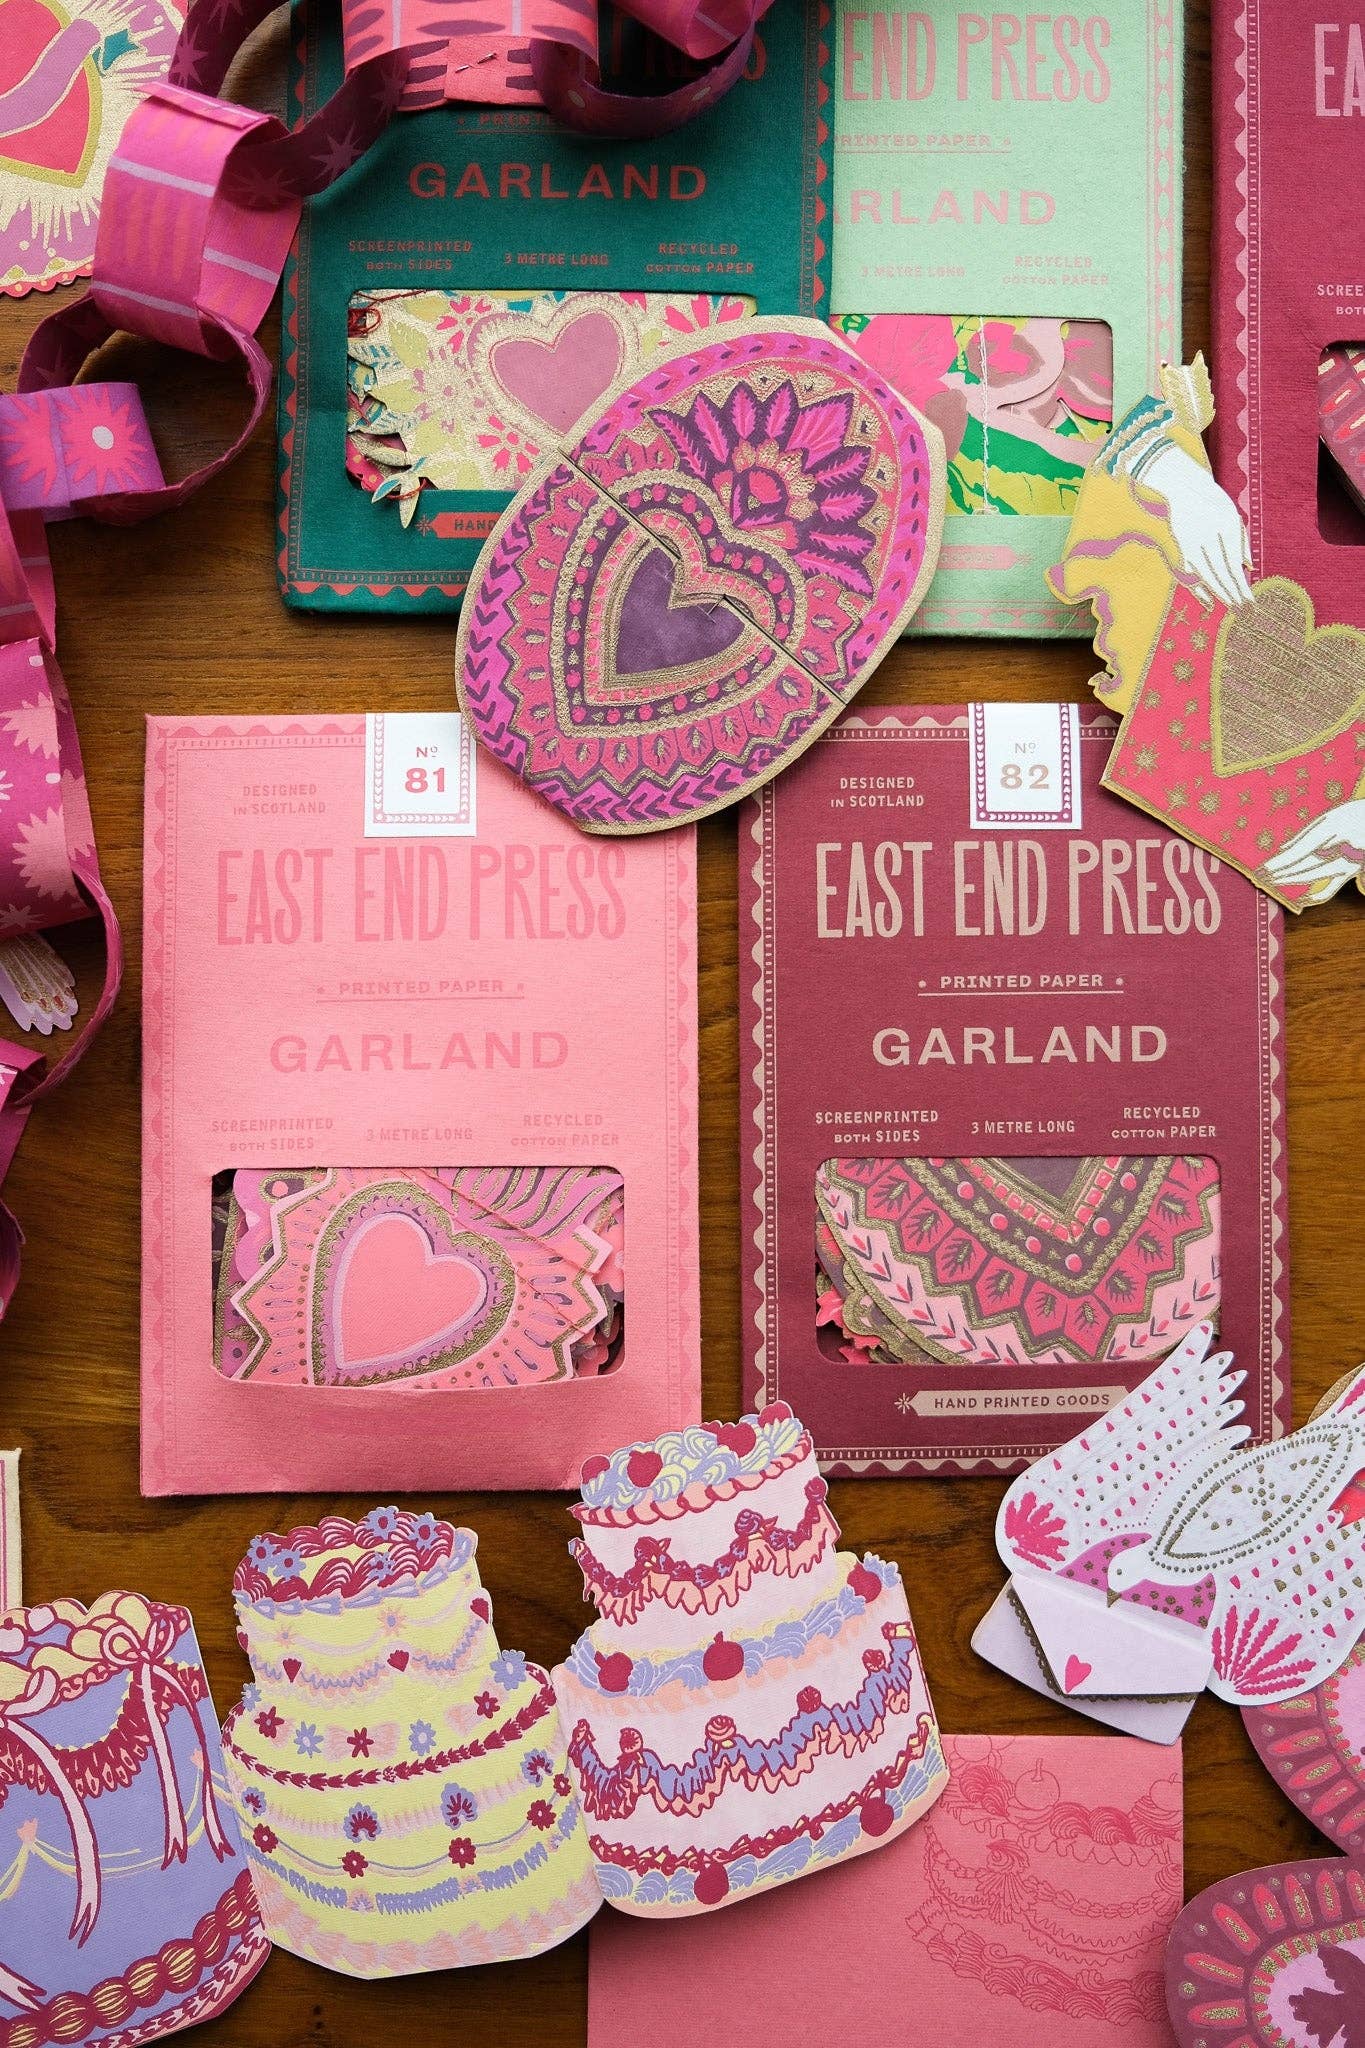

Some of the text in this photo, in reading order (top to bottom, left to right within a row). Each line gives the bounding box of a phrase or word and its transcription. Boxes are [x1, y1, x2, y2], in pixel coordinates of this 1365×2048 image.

[843, 11, 937, 101] END
[956, 13, 1112, 104] PRESS
[1314, 23, 1365, 117] EA
[927, 134, 991, 147] PAPER
[408, 162, 707, 200] GARLAND
[348, 240, 473, 254] SCREENPRINTED
[658, 242, 739, 255] RECYCLED
[366, 257, 454, 271] BOTH SIDES
[504, 253, 609, 266] 3 METRE LONG
[1014, 256, 1093, 269] RECYCLED
[645, 262, 755, 274] COTTON PAPER
[874, 265, 923, 278] METRE
[1002, 274, 1109, 287] COTTON PAPER
[1316, 284, 1364, 297] SCREE
[404, 767, 445, 793] 81
[839, 776, 915, 790] DESIGNED
[1000, 764, 1050, 790] 82
[242, 783, 318, 797] DESIGNED
[233, 801, 327, 816] IN SCOTLAND
[830, 794, 924, 808] IN SCOTLAND
[216, 843, 626, 946] EAST END PRESS
[816, 838, 1222, 939] EAST END PRESS
[339, 979, 504, 996] PRINTED PAPER
[940, 974, 1103, 990] PRINTED PAPER
[269, 1031, 570, 1074] GARLAND
[872, 1024, 1167, 1067] GARLAND
[522, 1113, 603, 1127] RECYCLED
[815, 1109, 939, 1125] SCREENPRINTED
[1123, 1106, 1200, 1120] RECYCLED
[211, 1117, 334, 1133] SCREENPRINTED
[971, 1119, 1076, 1135] 3 METRE LONG
[1111, 1124, 1217, 1139] COTTON PAPER
[366, 1127, 474, 1142] 3 METRE LONG
[510, 1133, 620, 1147] COTTON PAPER
[834, 1129, 920, 1144] BOTH SIDES
[229, 1136, 315, 1152] BOTH SIDES
[934, 1394, 1110, 1409] HAND PRINTED GOODS
